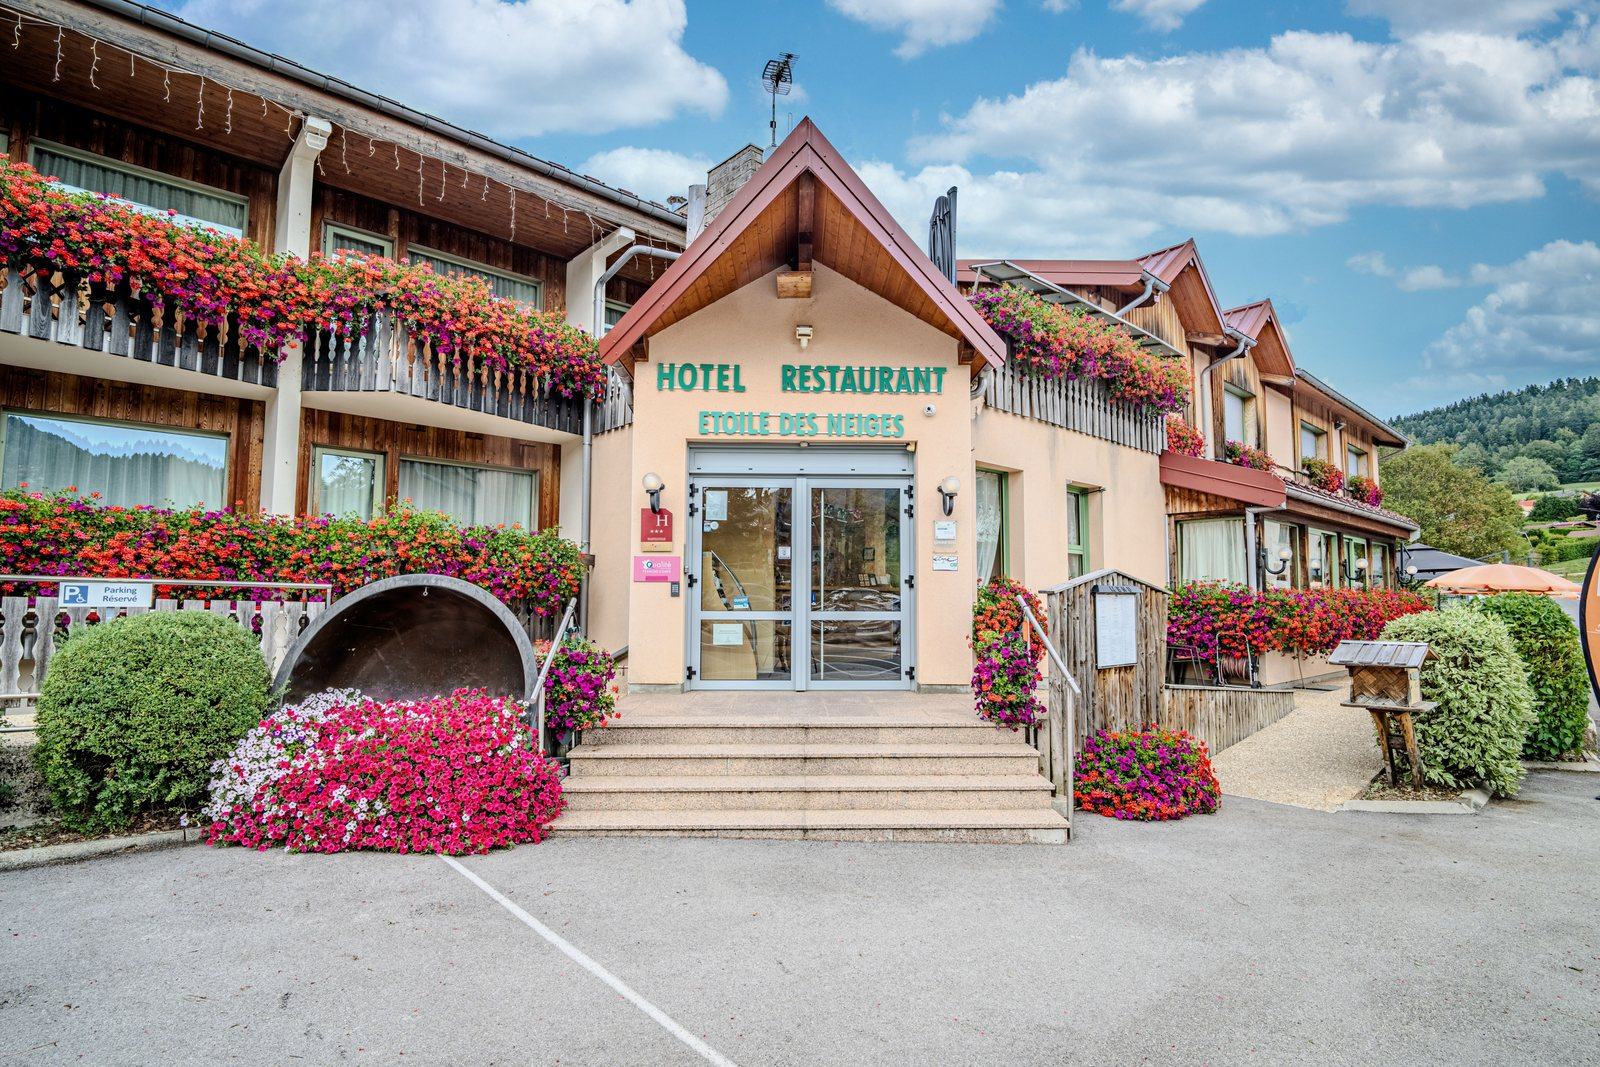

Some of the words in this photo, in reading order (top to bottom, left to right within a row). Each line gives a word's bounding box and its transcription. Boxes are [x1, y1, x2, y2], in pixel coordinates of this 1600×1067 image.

[657, 363, 746, 392] HOTEL
[782, 365, 947, 395] RESTAURANT
[699, 411, 770, 435] ETOILE
[779, 412, 819, 437] DES
[828, 413, 904, 438] NEIGES
[656, 515, 668, 527] H
[64, 586, 80, 601] P
[104, 587, 137, 595] Parking
